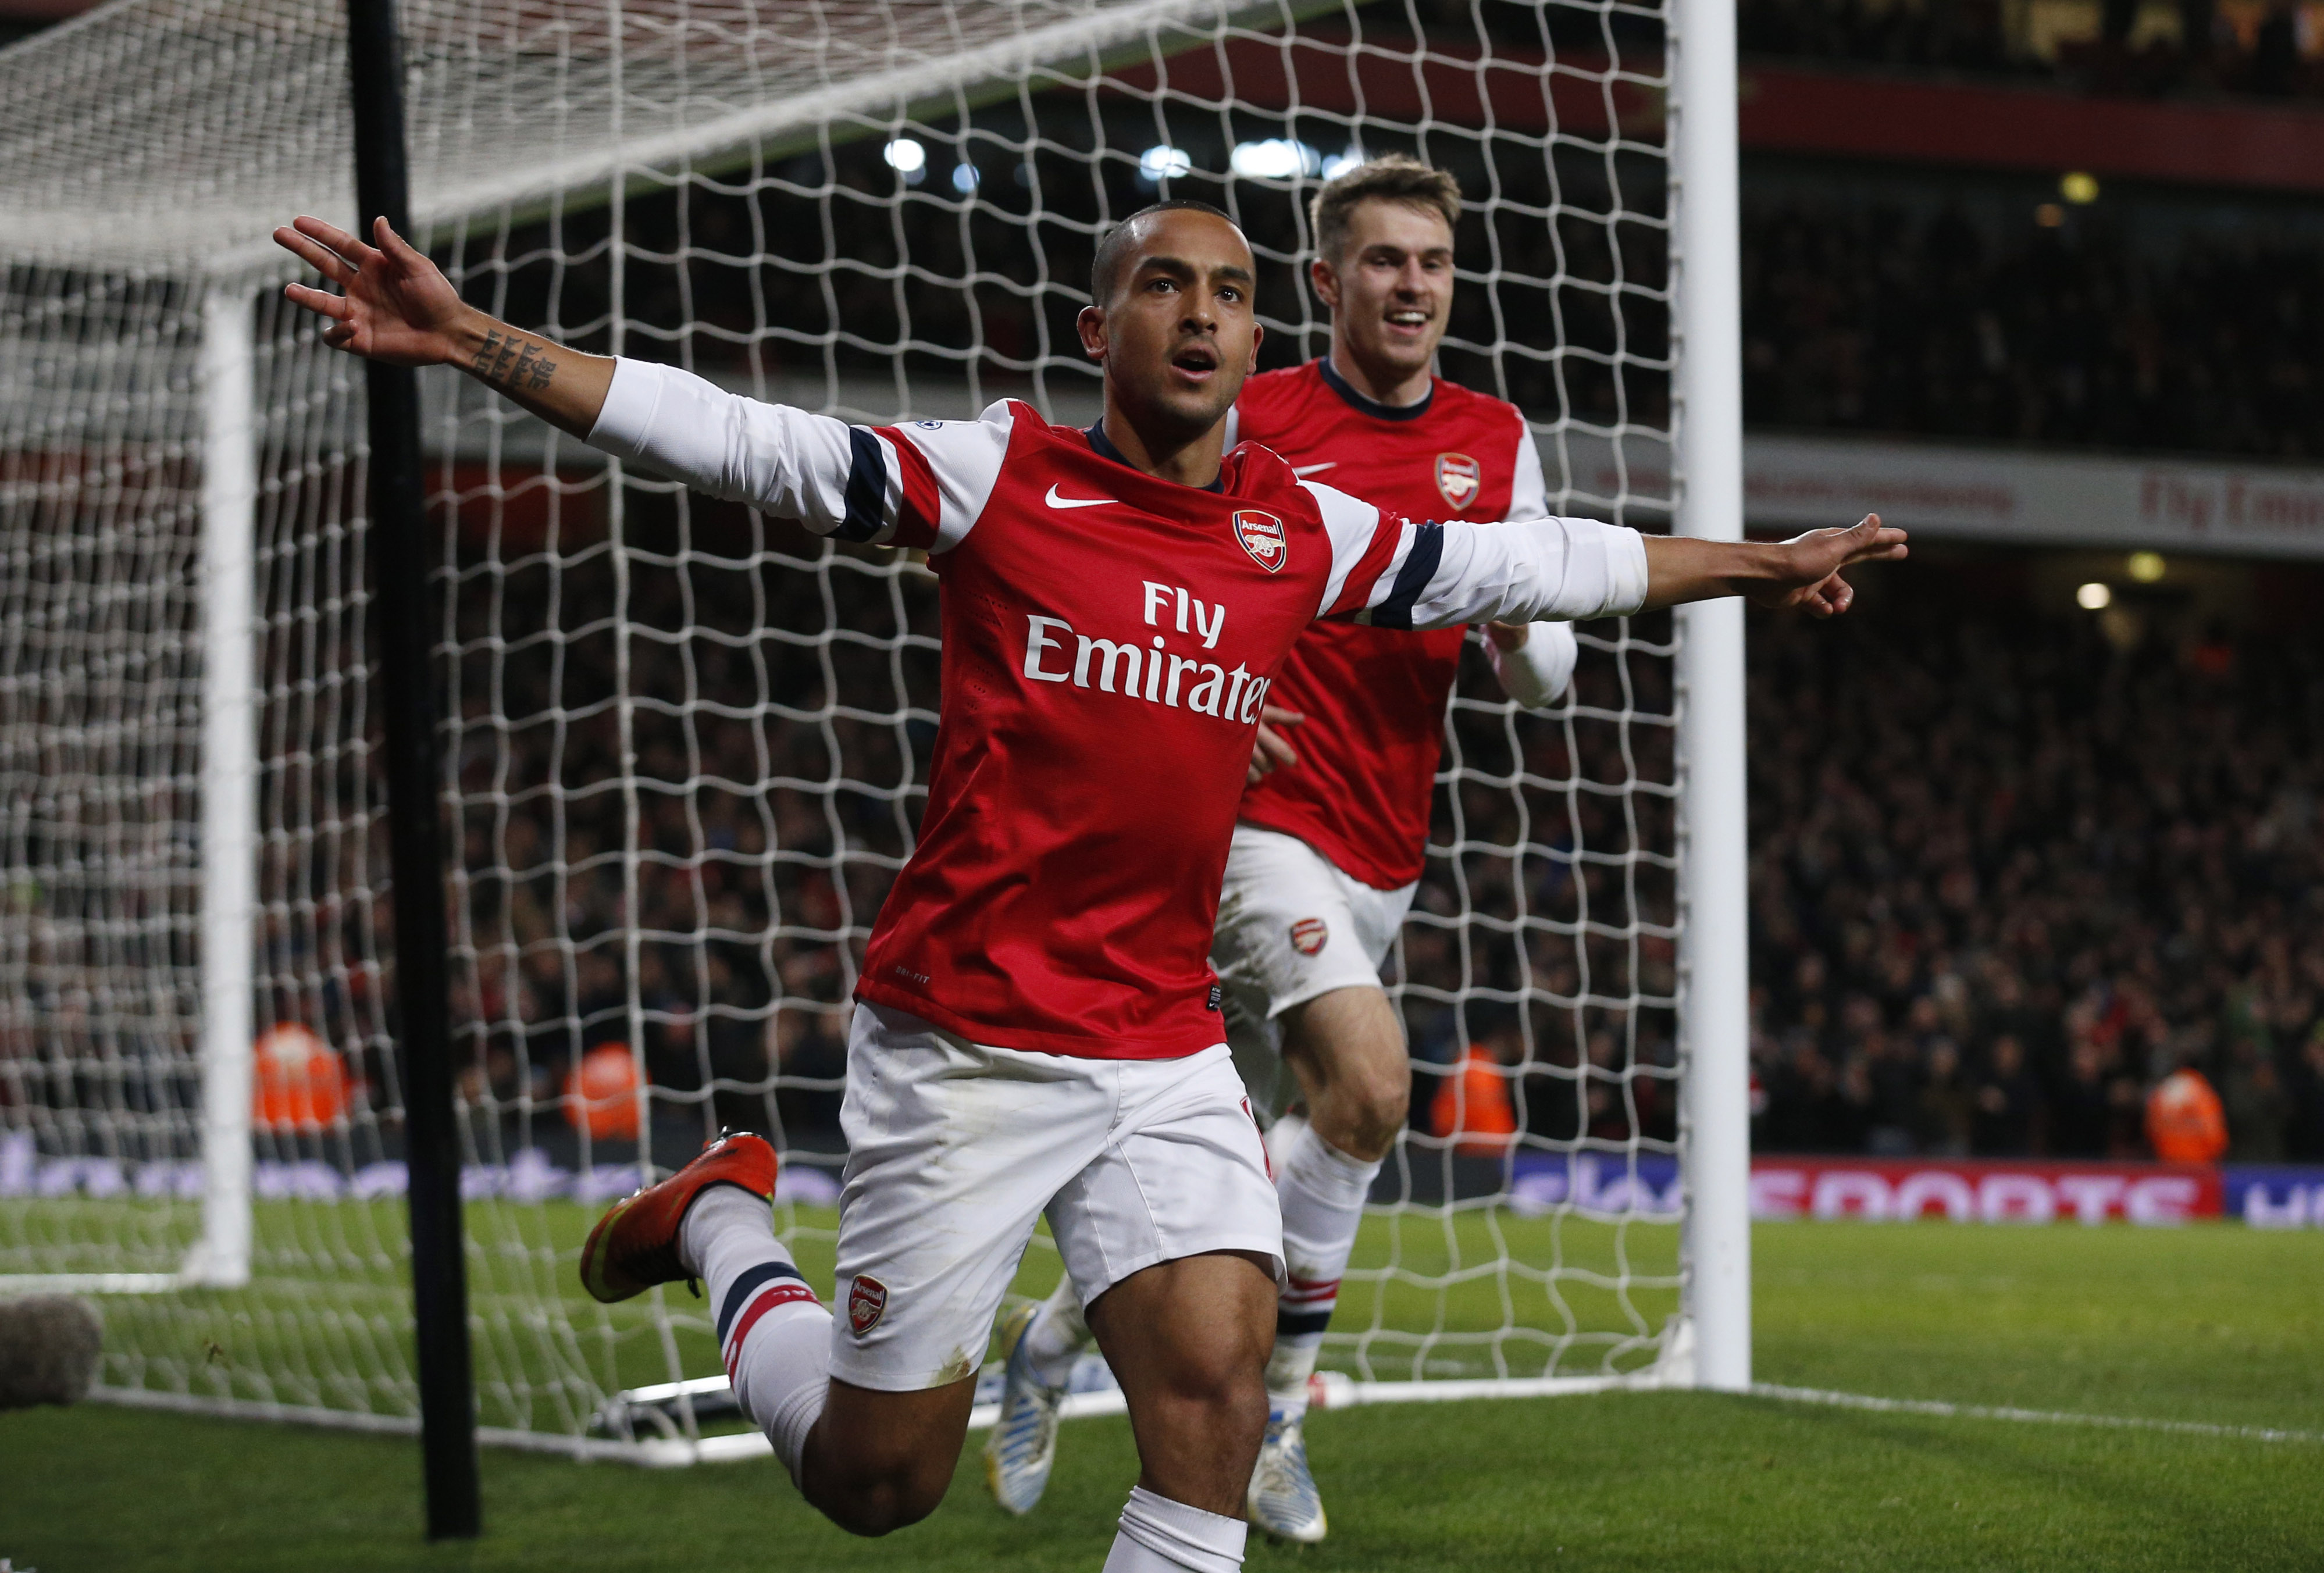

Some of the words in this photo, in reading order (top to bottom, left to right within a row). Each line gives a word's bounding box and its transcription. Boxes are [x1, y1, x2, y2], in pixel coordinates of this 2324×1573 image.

[1242, 519, 1278, 534] Arsenal
[1142, 580, 1225, 649] Fly
[896, 965, 930, 983] DRI-FIT
[854, 1280, 882, 1300] Arsenal
